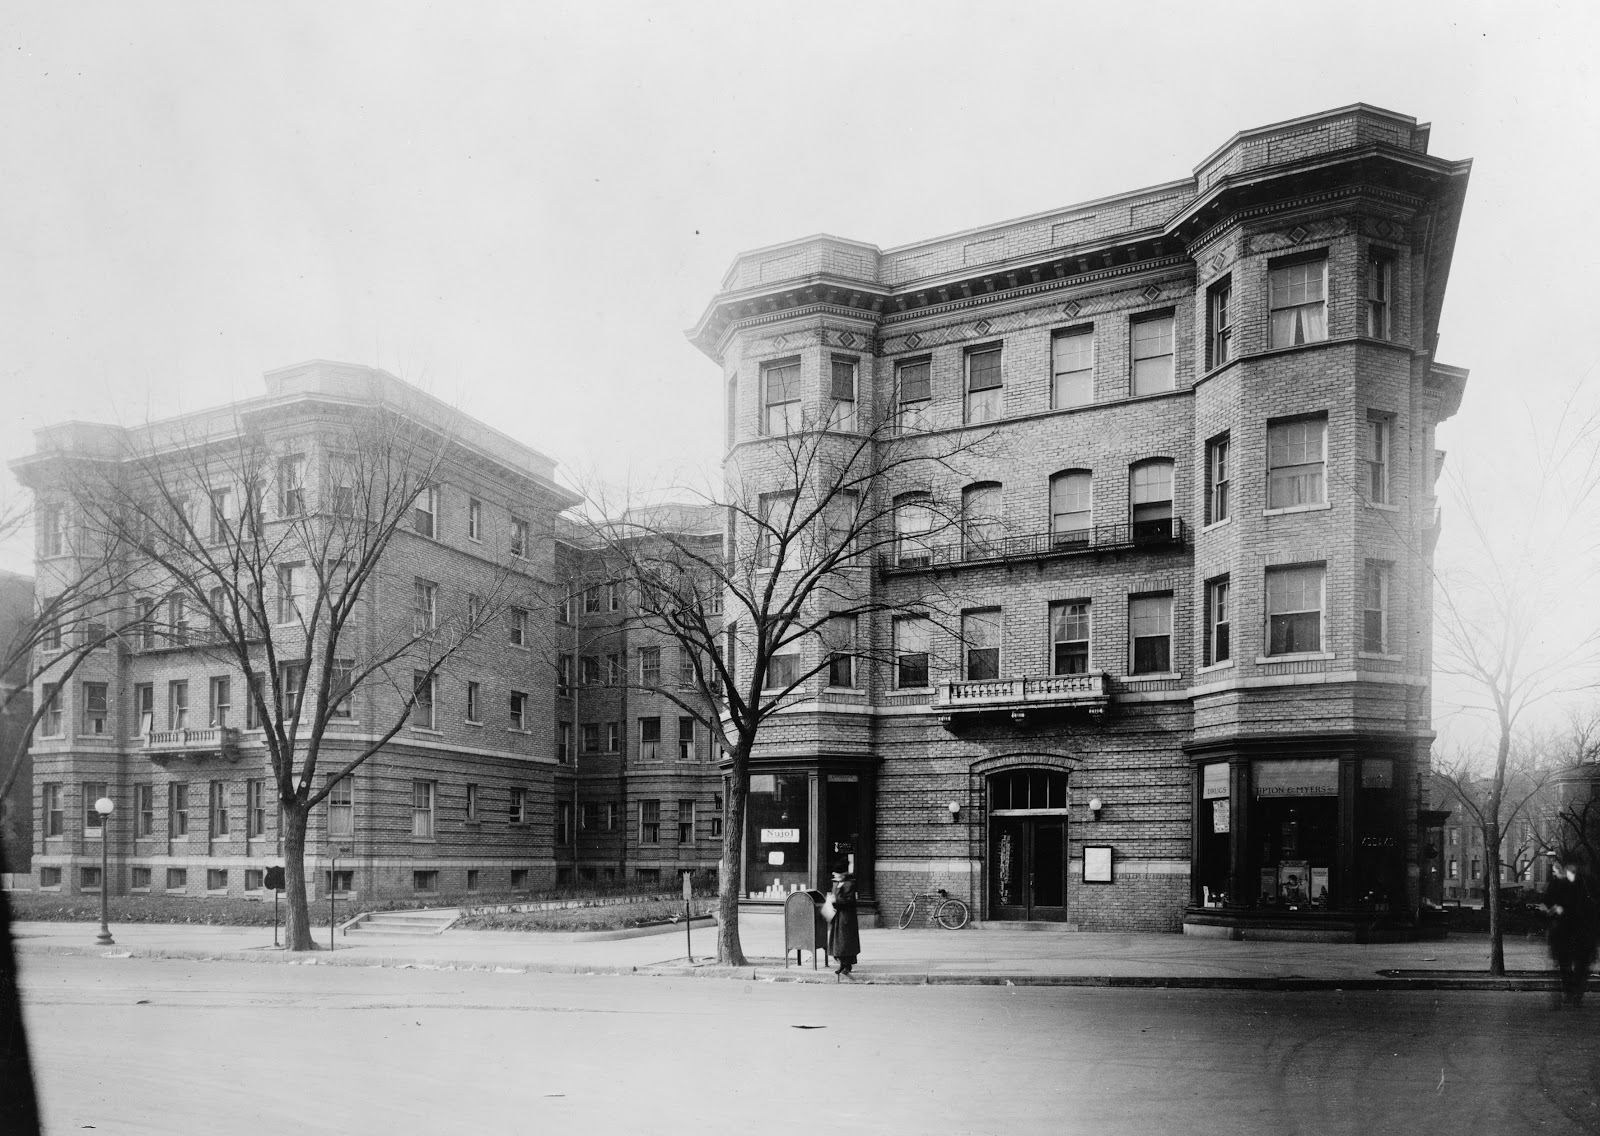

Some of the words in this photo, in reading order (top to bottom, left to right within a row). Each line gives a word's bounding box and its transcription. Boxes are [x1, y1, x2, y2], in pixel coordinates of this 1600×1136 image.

[1207, 786, 1227, 795] DRUGS
[1254, 786, 1285, 794] TIPTON
[1287, 786, 1294, 794] &
[1296, 785, 1326, 793] MYERS
[766, 829, 794, 838] Nujol
